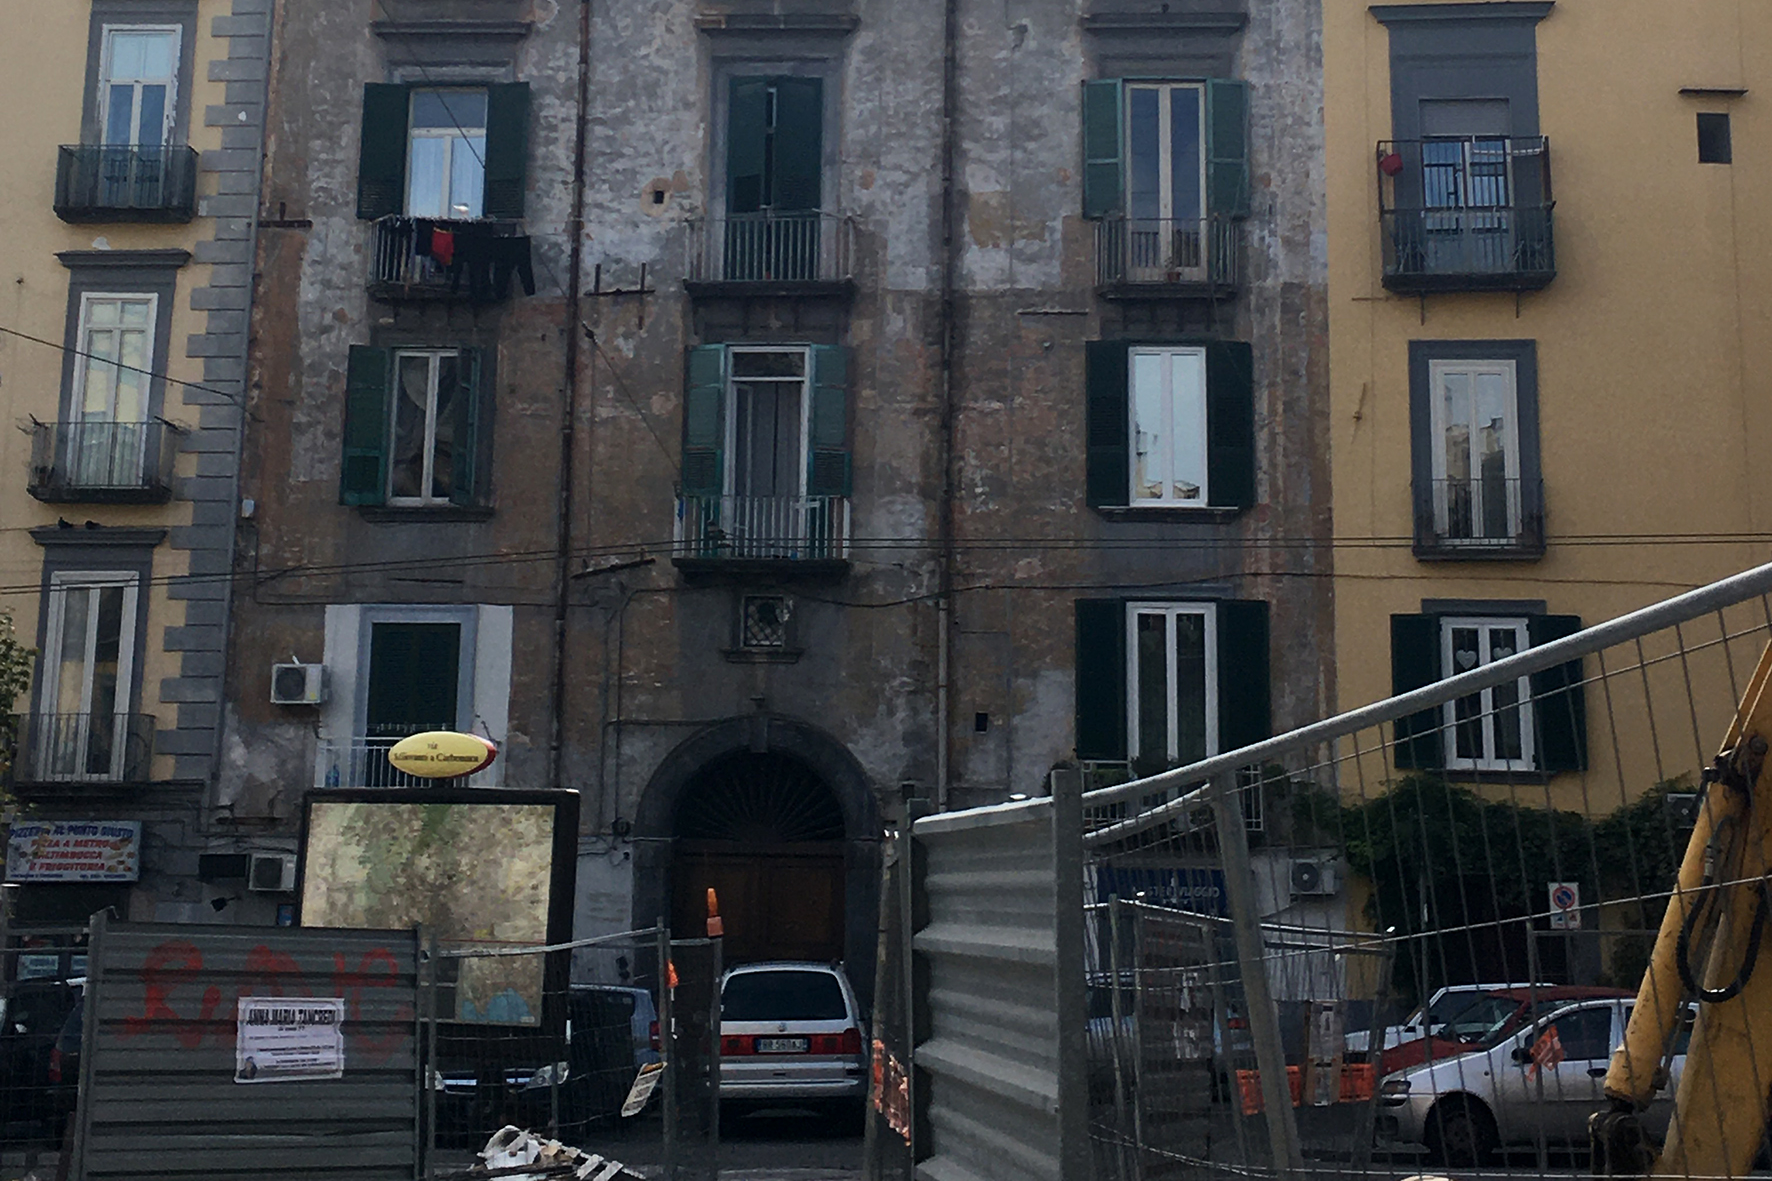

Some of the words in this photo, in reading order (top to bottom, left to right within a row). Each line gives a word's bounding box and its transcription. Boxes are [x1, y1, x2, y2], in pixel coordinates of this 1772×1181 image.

[101, 826, 134, 838] GIUSTO
[62, 839, 70, 848] A
[74, 839, 110, 848] METRO
[39, 862, 105, 871] FRIGGITORIA
[247, 1008, 269, 1026] ANNA
[270, 1008, 296, 1025] MARIA
